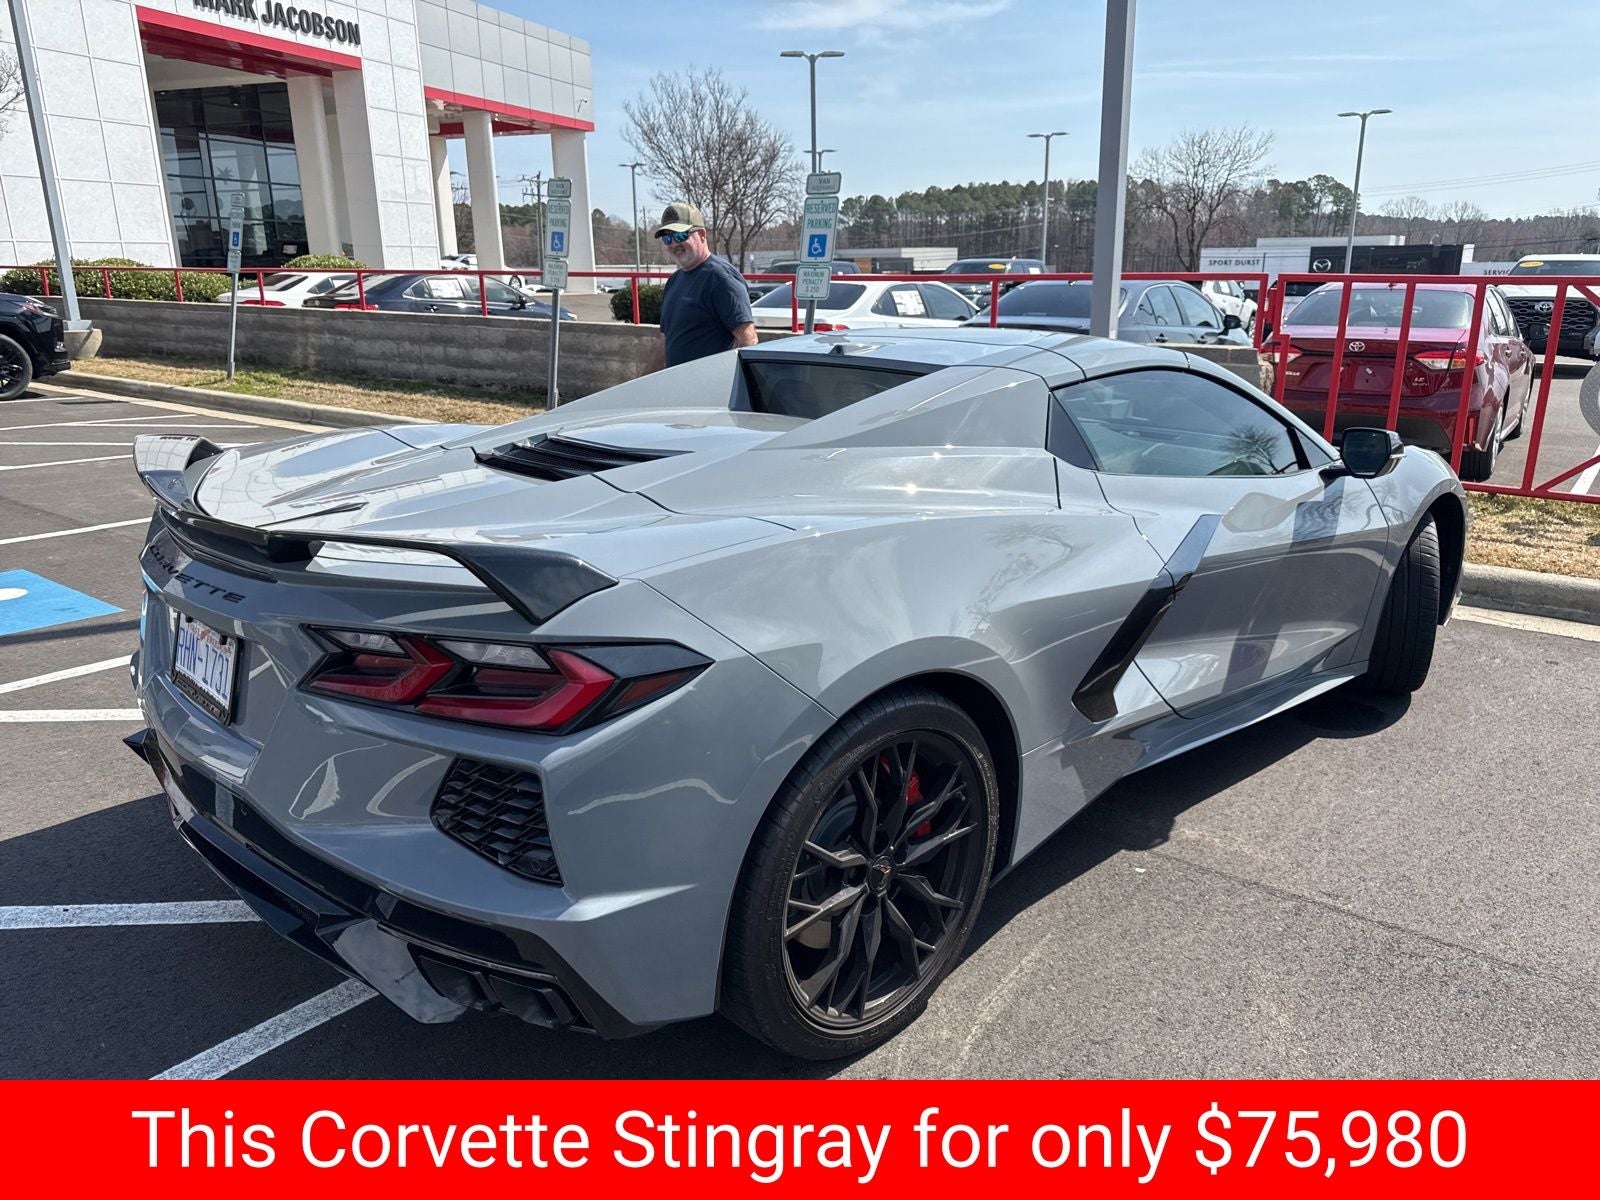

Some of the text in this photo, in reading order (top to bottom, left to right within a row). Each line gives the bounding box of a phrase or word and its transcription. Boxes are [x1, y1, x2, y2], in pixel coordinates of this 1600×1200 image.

[261, 0, 361, 46] JACOBSON
[818, 177, 831, 185] VAN
[806, 202, 836, 214] RESERVED
[807, 218, 832, 229] PARKING
[149, 545, 246, 603] CORVETTE
[177, 626, 230, 699] RHN-1731
